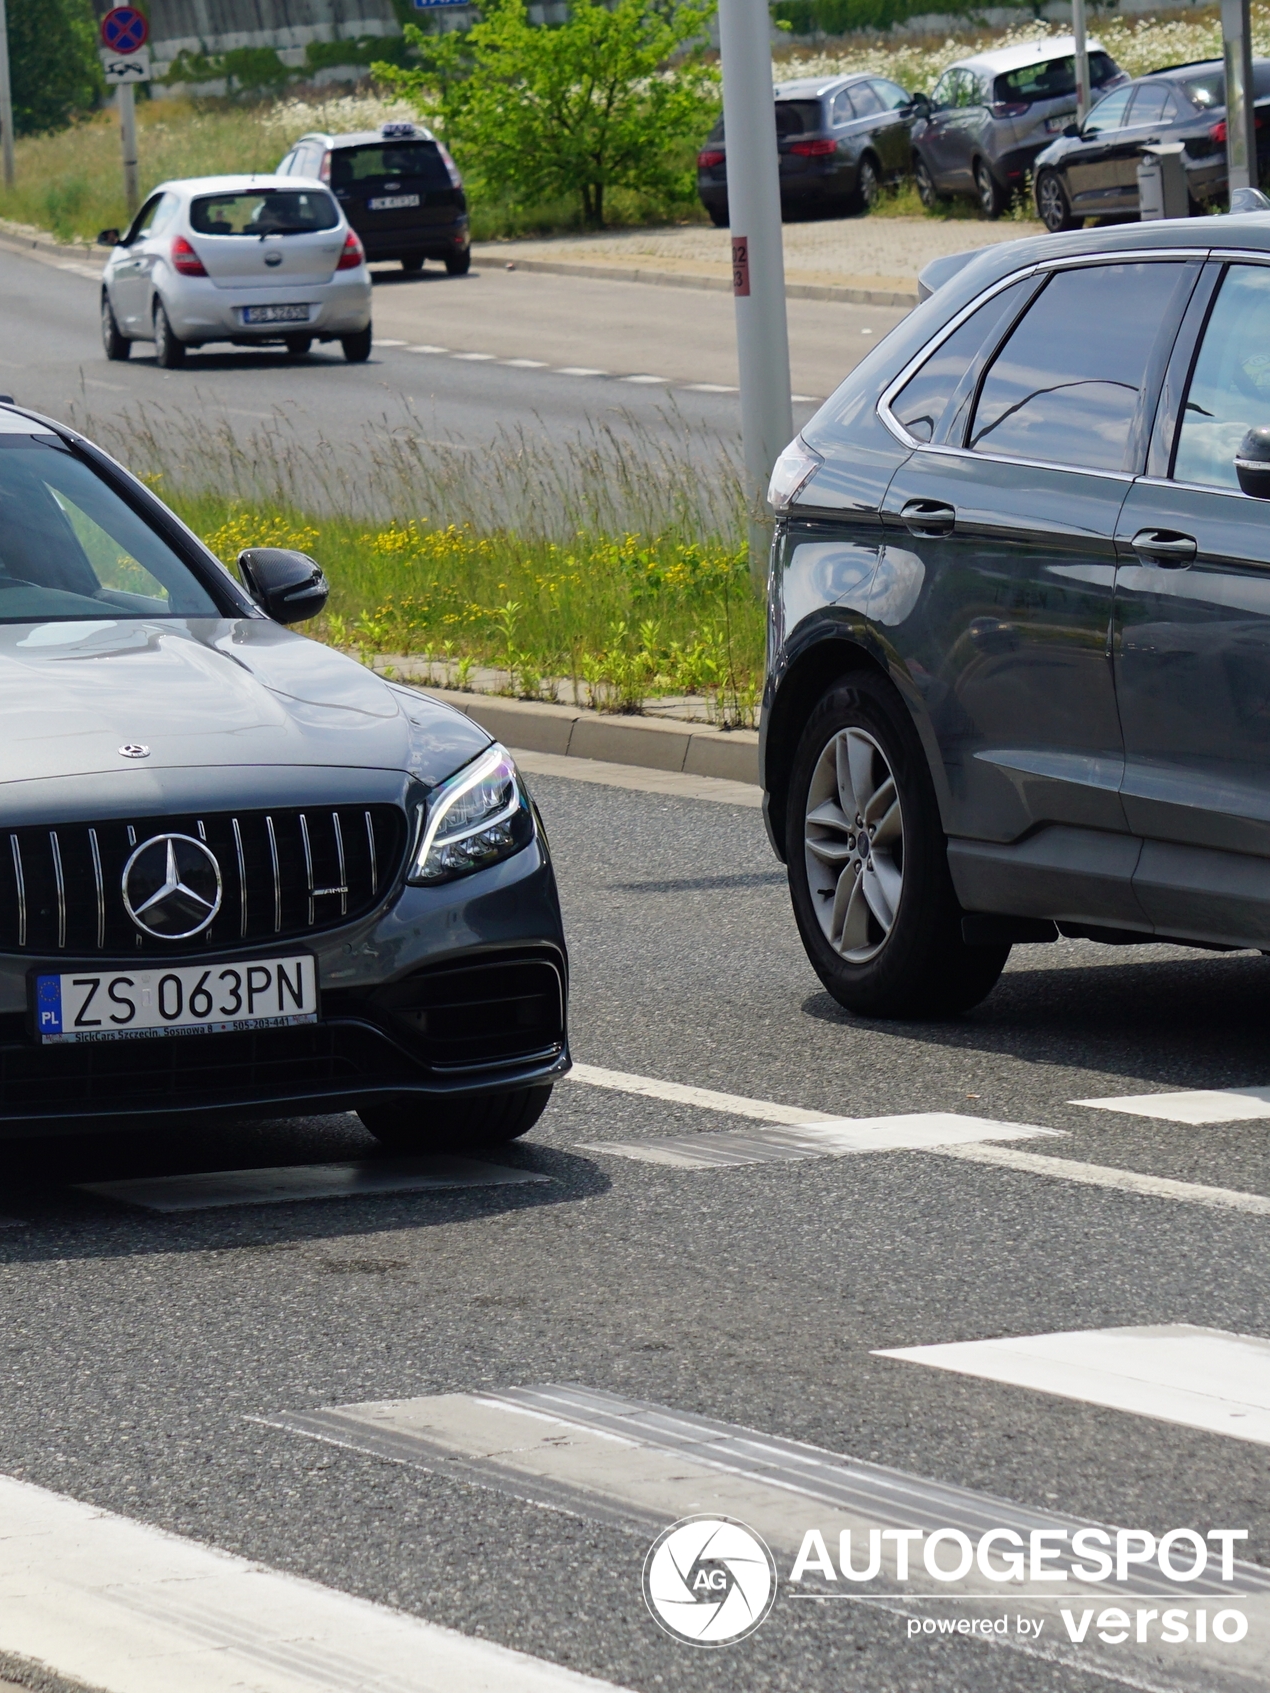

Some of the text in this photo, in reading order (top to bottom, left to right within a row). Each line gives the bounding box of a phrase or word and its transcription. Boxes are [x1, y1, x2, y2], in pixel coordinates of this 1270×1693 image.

[324, 886, 348, 896] AMG
[72, 962, 304, 1026] ZS 063PN
[41, 1011, 59, 1025] PL
[164, 1026, 205, 1037] Sosnowa
